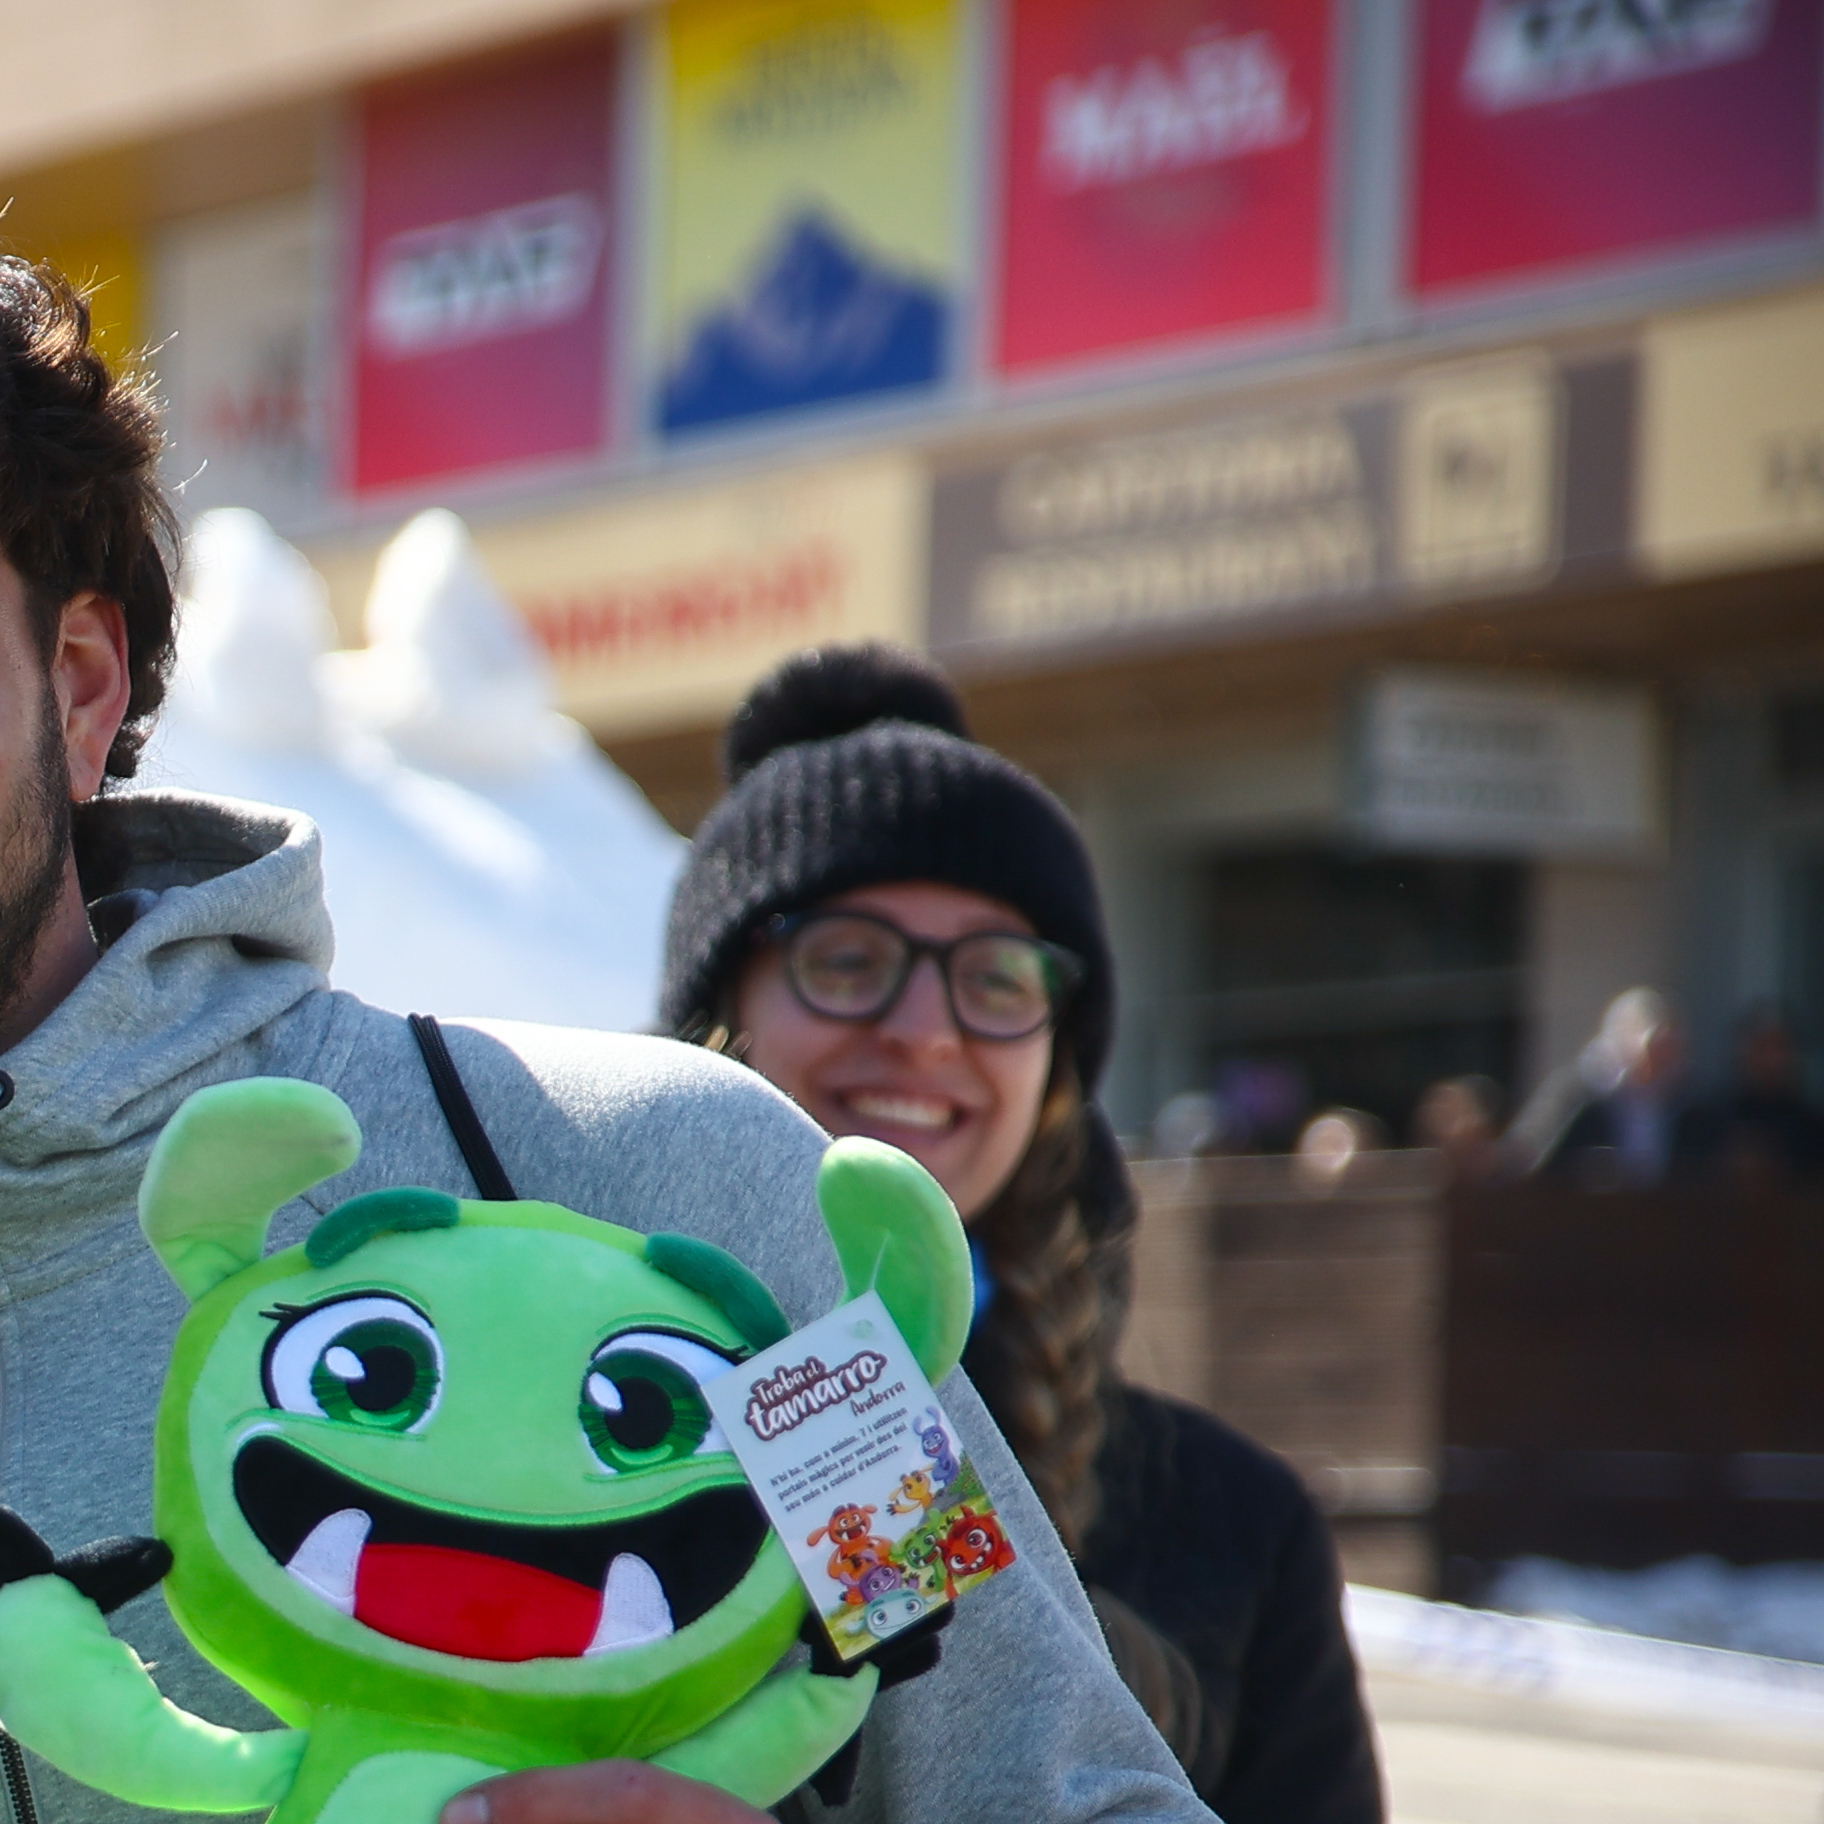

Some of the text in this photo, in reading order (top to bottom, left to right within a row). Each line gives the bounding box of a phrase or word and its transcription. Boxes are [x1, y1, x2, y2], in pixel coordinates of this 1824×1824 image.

[749, 1355, 881, 1437] tamarro
[756, 1361, 820, 1404] Troba el
[851, 1381, 907, 1417] Andorra
[873, 1407, 908, 1431] utilitzen
[778, 1480, 808, 1501] portals
[840, 1453, 854, 1467] per
[877, 1432, 893, 1445] des
